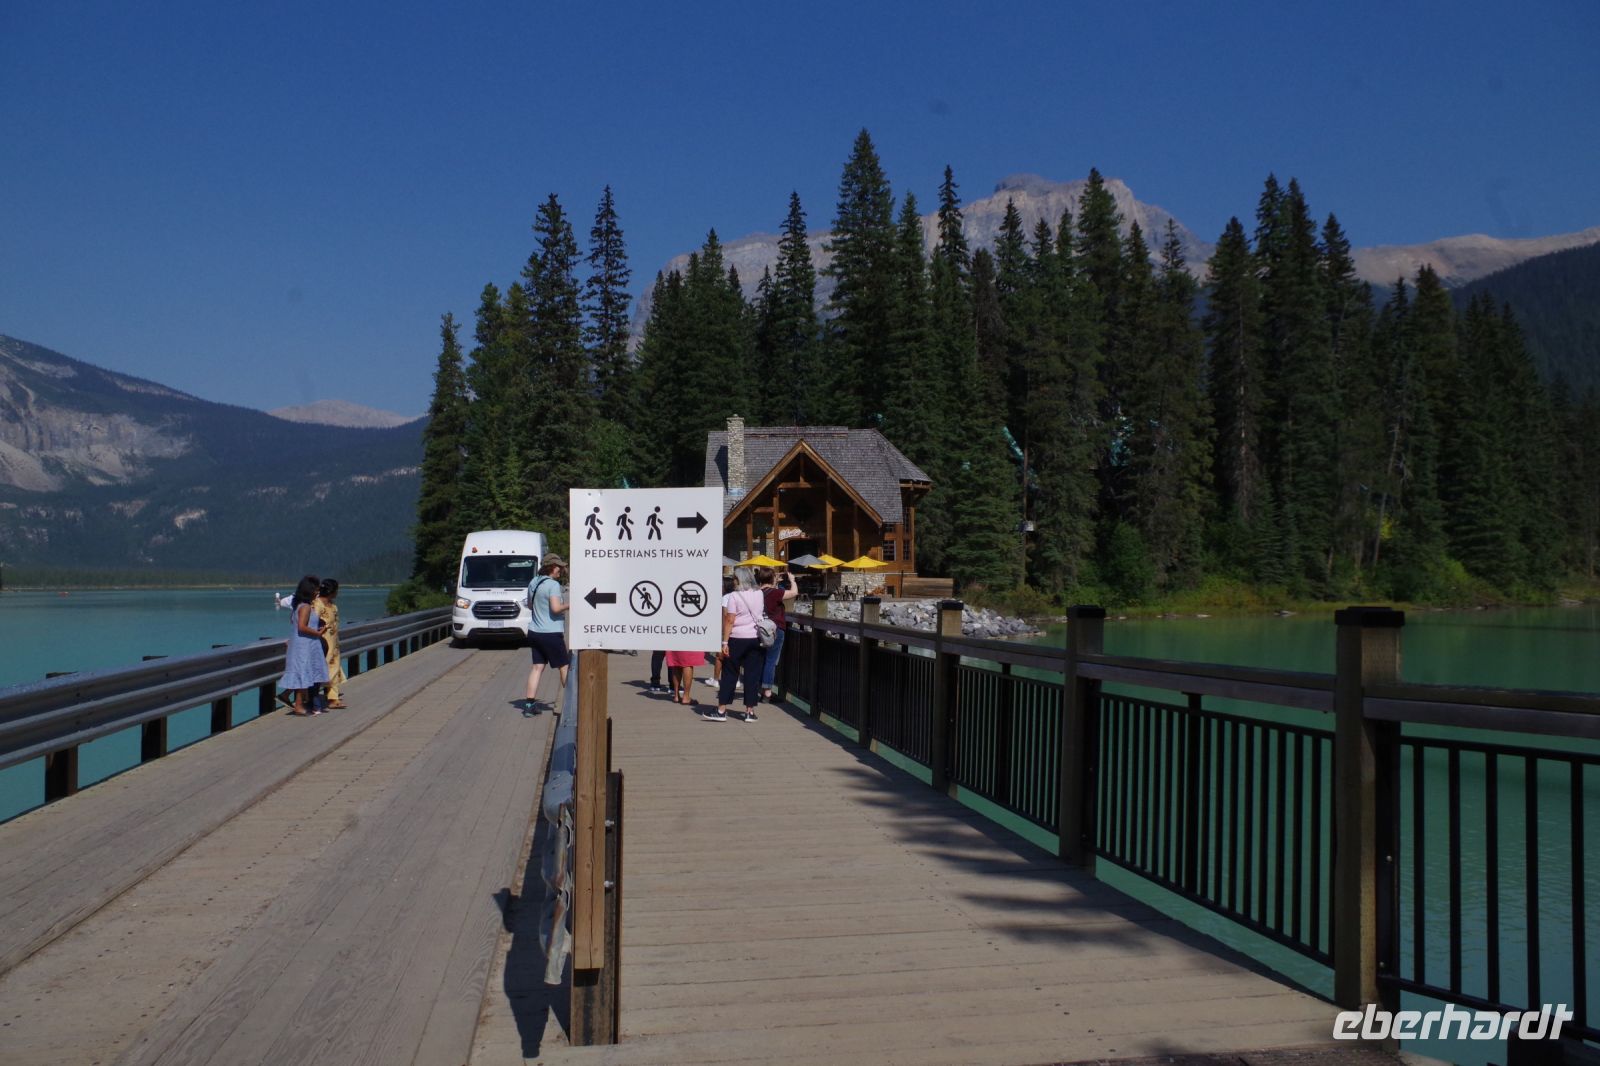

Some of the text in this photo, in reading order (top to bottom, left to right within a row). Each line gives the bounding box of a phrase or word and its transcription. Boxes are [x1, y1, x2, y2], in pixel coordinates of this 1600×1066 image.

[584, 549, 709, 558] PEDESTRIANS THIS WAY
[583, 625, 708, 635] SERVICE VEHICLES ONLY
